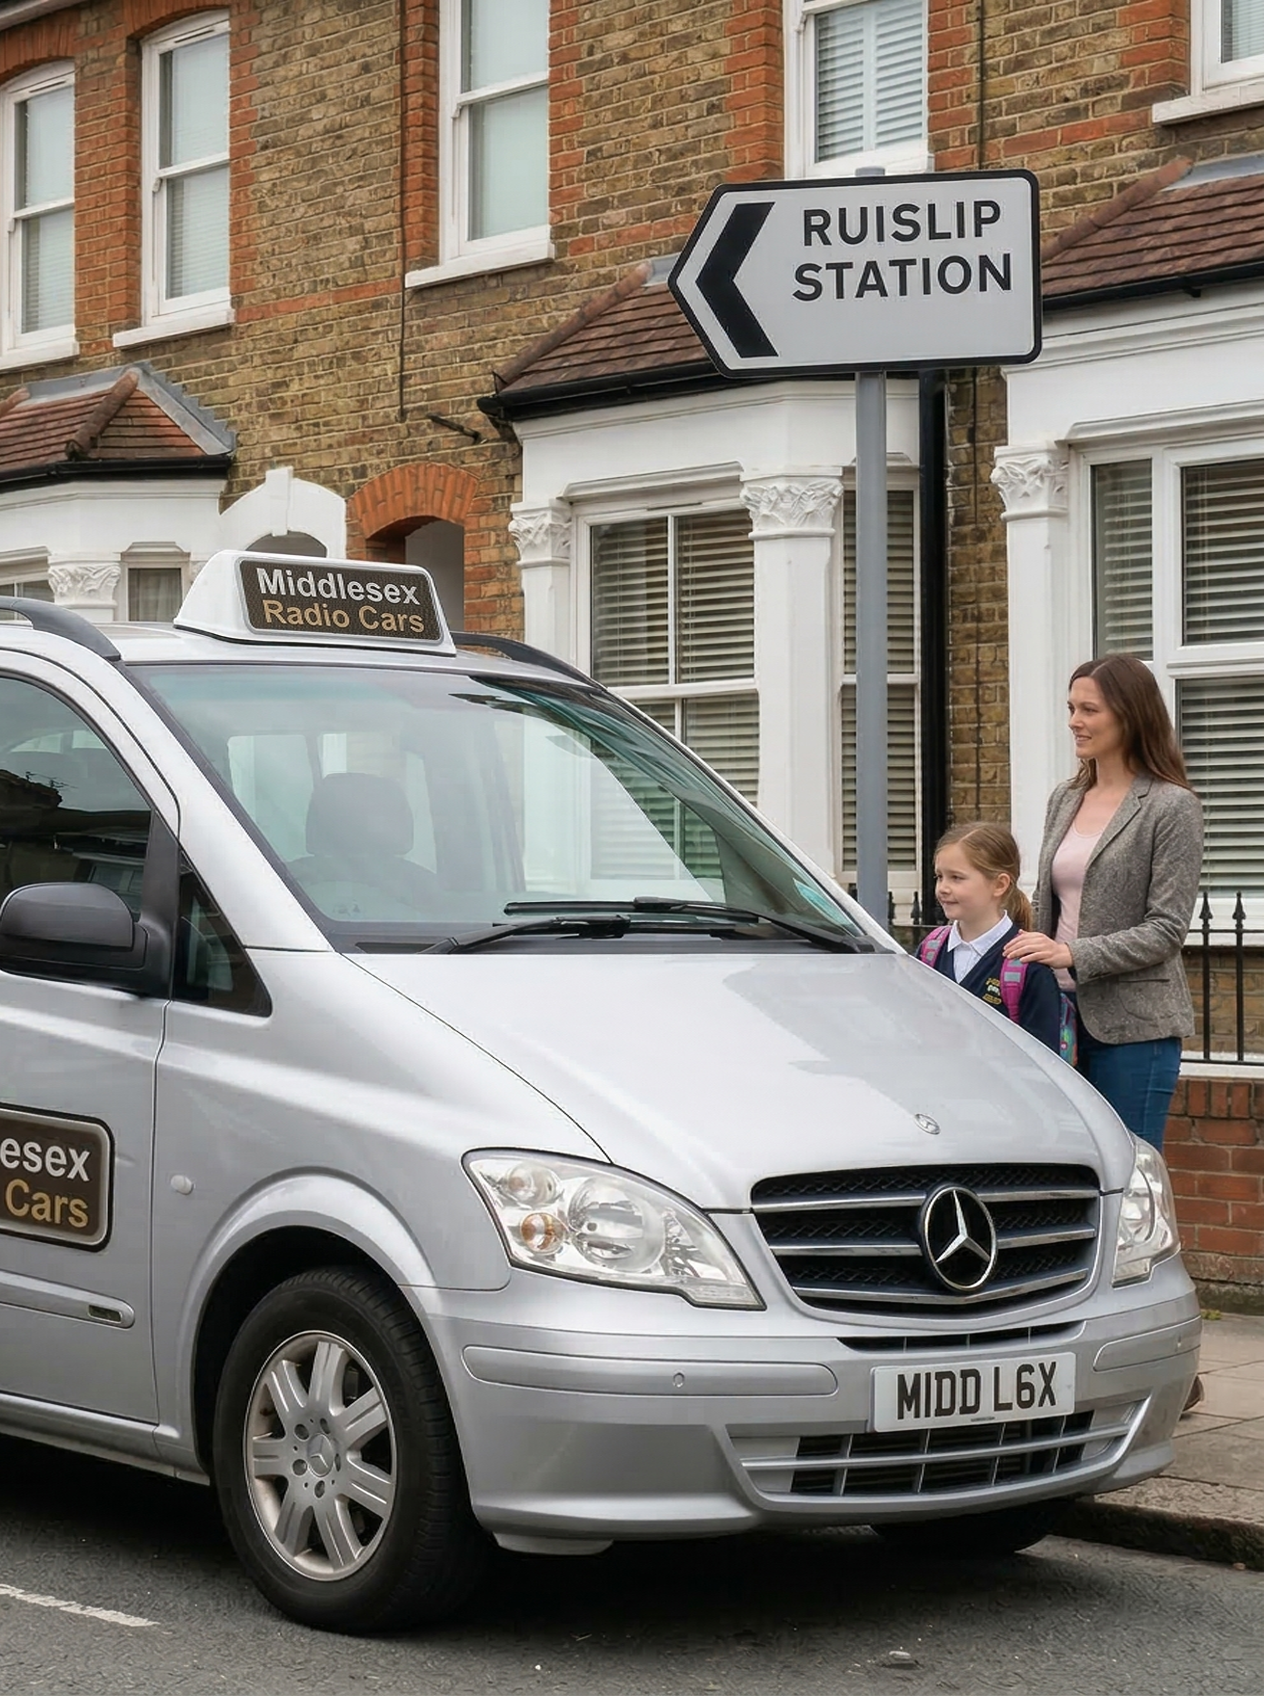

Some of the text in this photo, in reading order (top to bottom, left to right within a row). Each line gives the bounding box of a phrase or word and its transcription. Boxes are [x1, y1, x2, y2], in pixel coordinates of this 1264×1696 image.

[803, 200, 1001, 247] RUISLIP
[792, 253, 1012, 302] STATION
[256, 567, 421, 606] Middlesex
[262, 599, 425, 633] Radio Cars
[5, 1178, 89, 1228] Cars
[897, 1361, 1057, 1420] MIDD L6X
